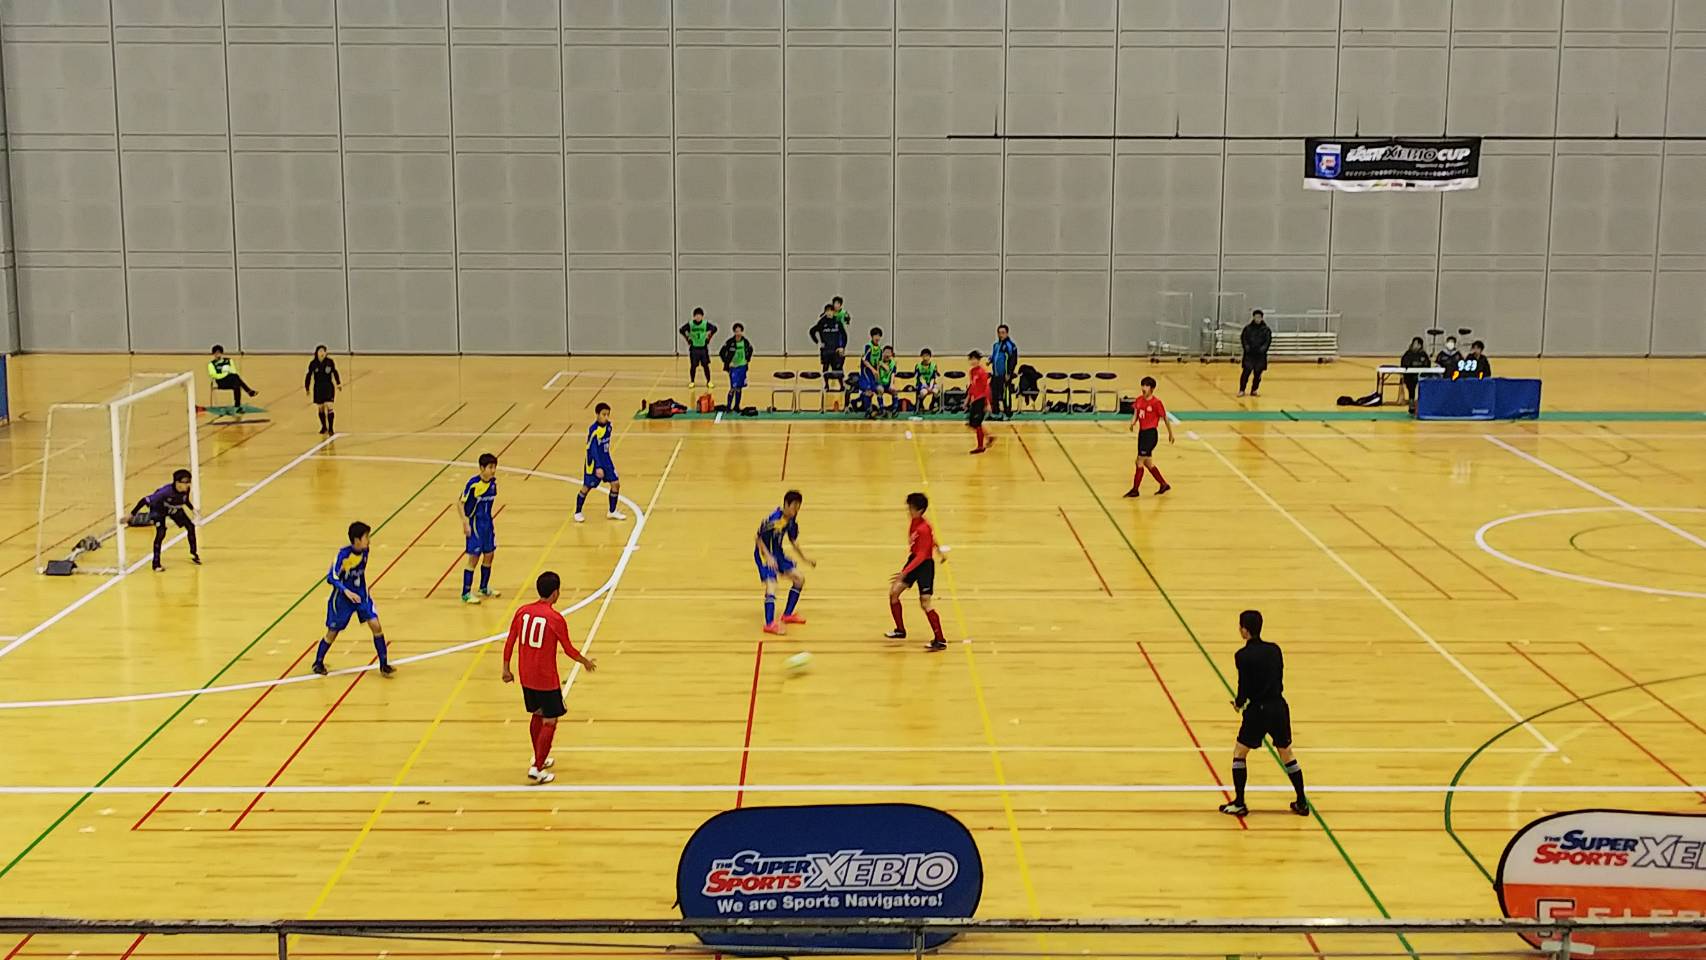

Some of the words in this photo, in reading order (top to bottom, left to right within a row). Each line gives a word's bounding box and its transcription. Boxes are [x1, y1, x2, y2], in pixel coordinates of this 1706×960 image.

[1438, 148, 1471, 161] CUP
[521, 613, 547, 649] 10
[1560, 829, 1639, 852] SUPER
[731, 852, 812, 876] SUPER
[1533, 843, 1629, 867] SPORTS
[807, 850, 957, 890] XEBIO
[706, 871, 802, 893] SPORTS
[717, 899, 744, 914] We
[749, 899, 777, 911] are
[782, 895, 840, 912] Sports
[845, 893, 943, 910] Navigators!
